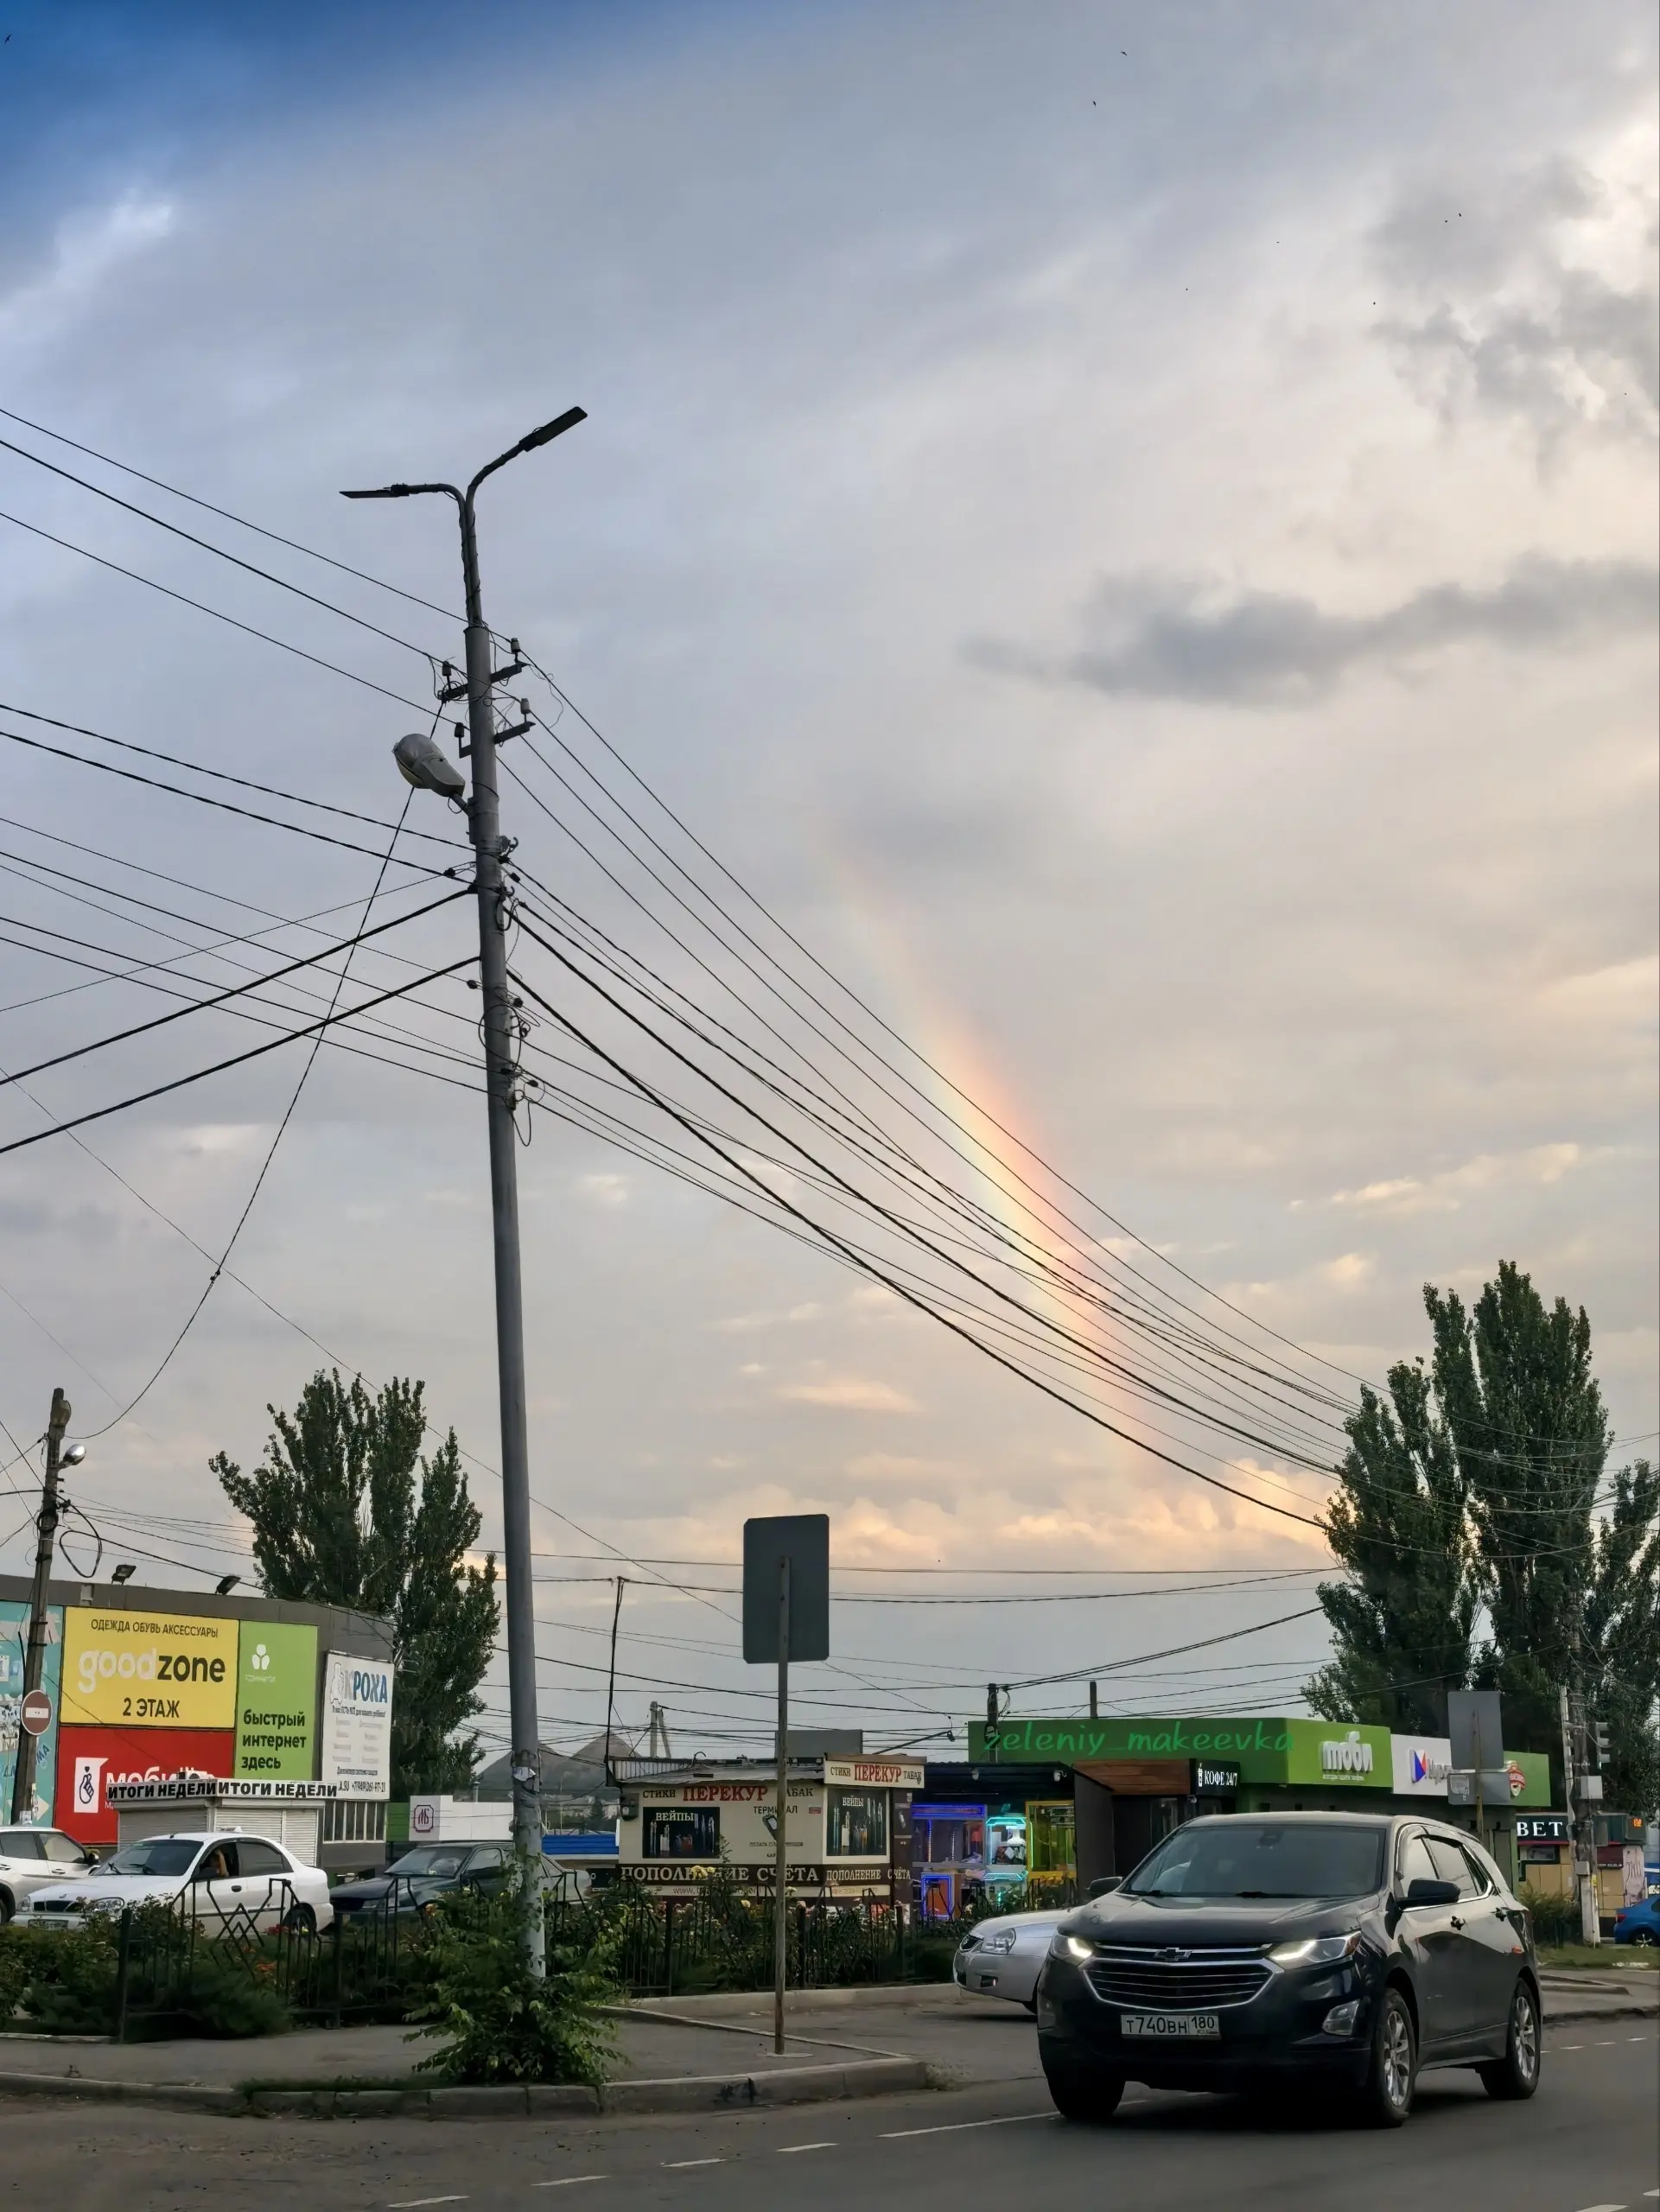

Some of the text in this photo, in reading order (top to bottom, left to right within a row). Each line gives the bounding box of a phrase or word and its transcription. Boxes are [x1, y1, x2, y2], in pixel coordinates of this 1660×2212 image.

[91, 1618, 219, 1638] ОДЕЖДА ОБУВЬ АКСЕССУАРЫ
[78, 1647, 226, 1694] goodzone
[122, 1697, 181, 1718] 2 ЭТАЖ
[243, 1708, 305, 1730] быстрый
[242, 1733, 307, 1751] интернет
[240, 1755, 282, 1771] здесь
[854, 1764, 902, 1783] ПЕРЕКУР
[1205, 1770, 1225, 1786] КОФЕ
[108, 1783, 217, 1800] ИТОГИ НЕДЕЛИ
[219, 1782, 337, 1798] ИТОГИ НЕДЕЛИ
[642, 1789, 676, 1799] СТИКИ
[683, 1785, 769, 1802] ПЕРЕКУР
[655, 1810, 695, 1821] ВЕЙПЫ
[753, 1805, 798, 1815] ТЕРМИАЛ
[826, 1868, 881, 1881] ПОПОЛНЕНИЕ
[1191, 2016, 1215, 2029] 180
